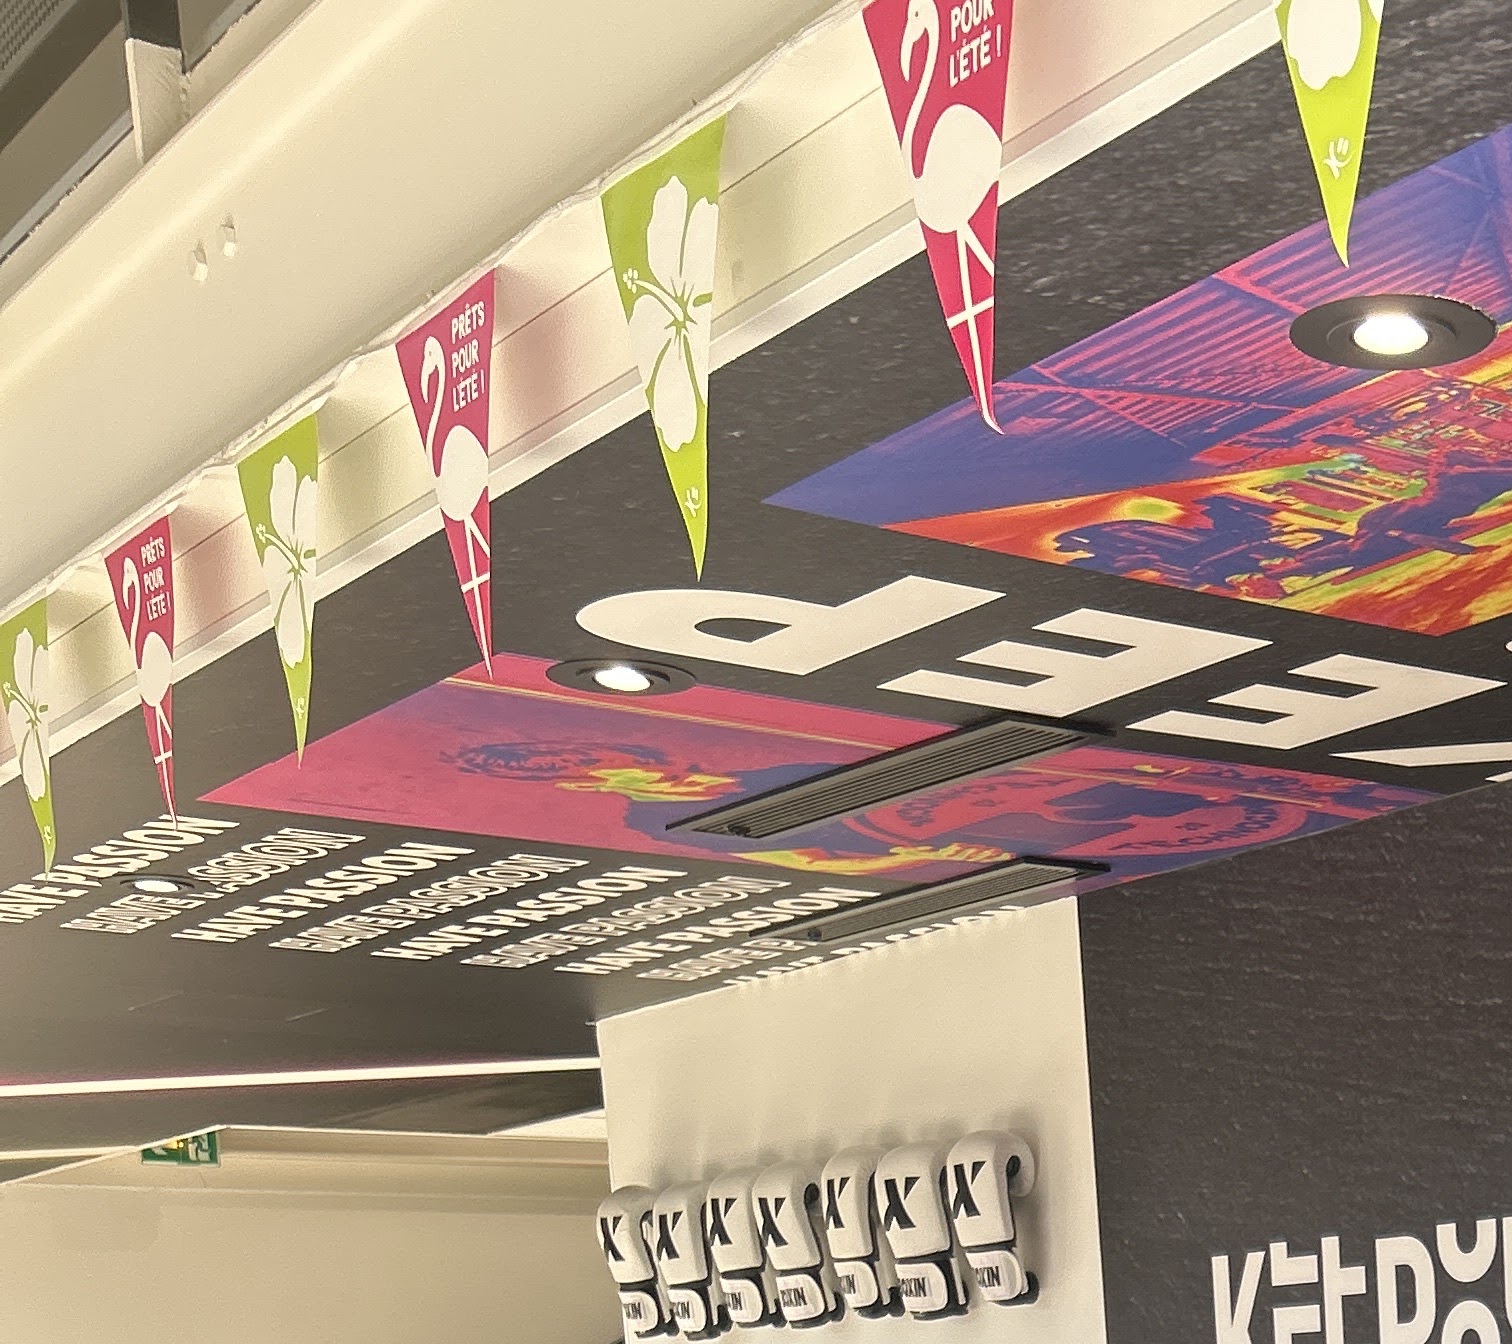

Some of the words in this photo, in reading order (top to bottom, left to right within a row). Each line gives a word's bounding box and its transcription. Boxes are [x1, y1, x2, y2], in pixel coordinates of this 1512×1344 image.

[950, 25, 992, 88] L'ÉTÉ
[451, 300, 485, 345] PRÊTS
[451, 338, 480, 379] POUR
[143, 566, 165, 594] POUR
[31, 814, 240, 887] PASSION
[171, 905, 309, 943] HAVE
[259, 842, 476, 909] PASSION
[360, 853, 590, 919] PASSION
[370, 924, 510, 961] HAVE
[466, 866, 688, 928] PASSION
[554, 941, 692, 975] HAVE
[656, 887, 882, 943] PASSION
